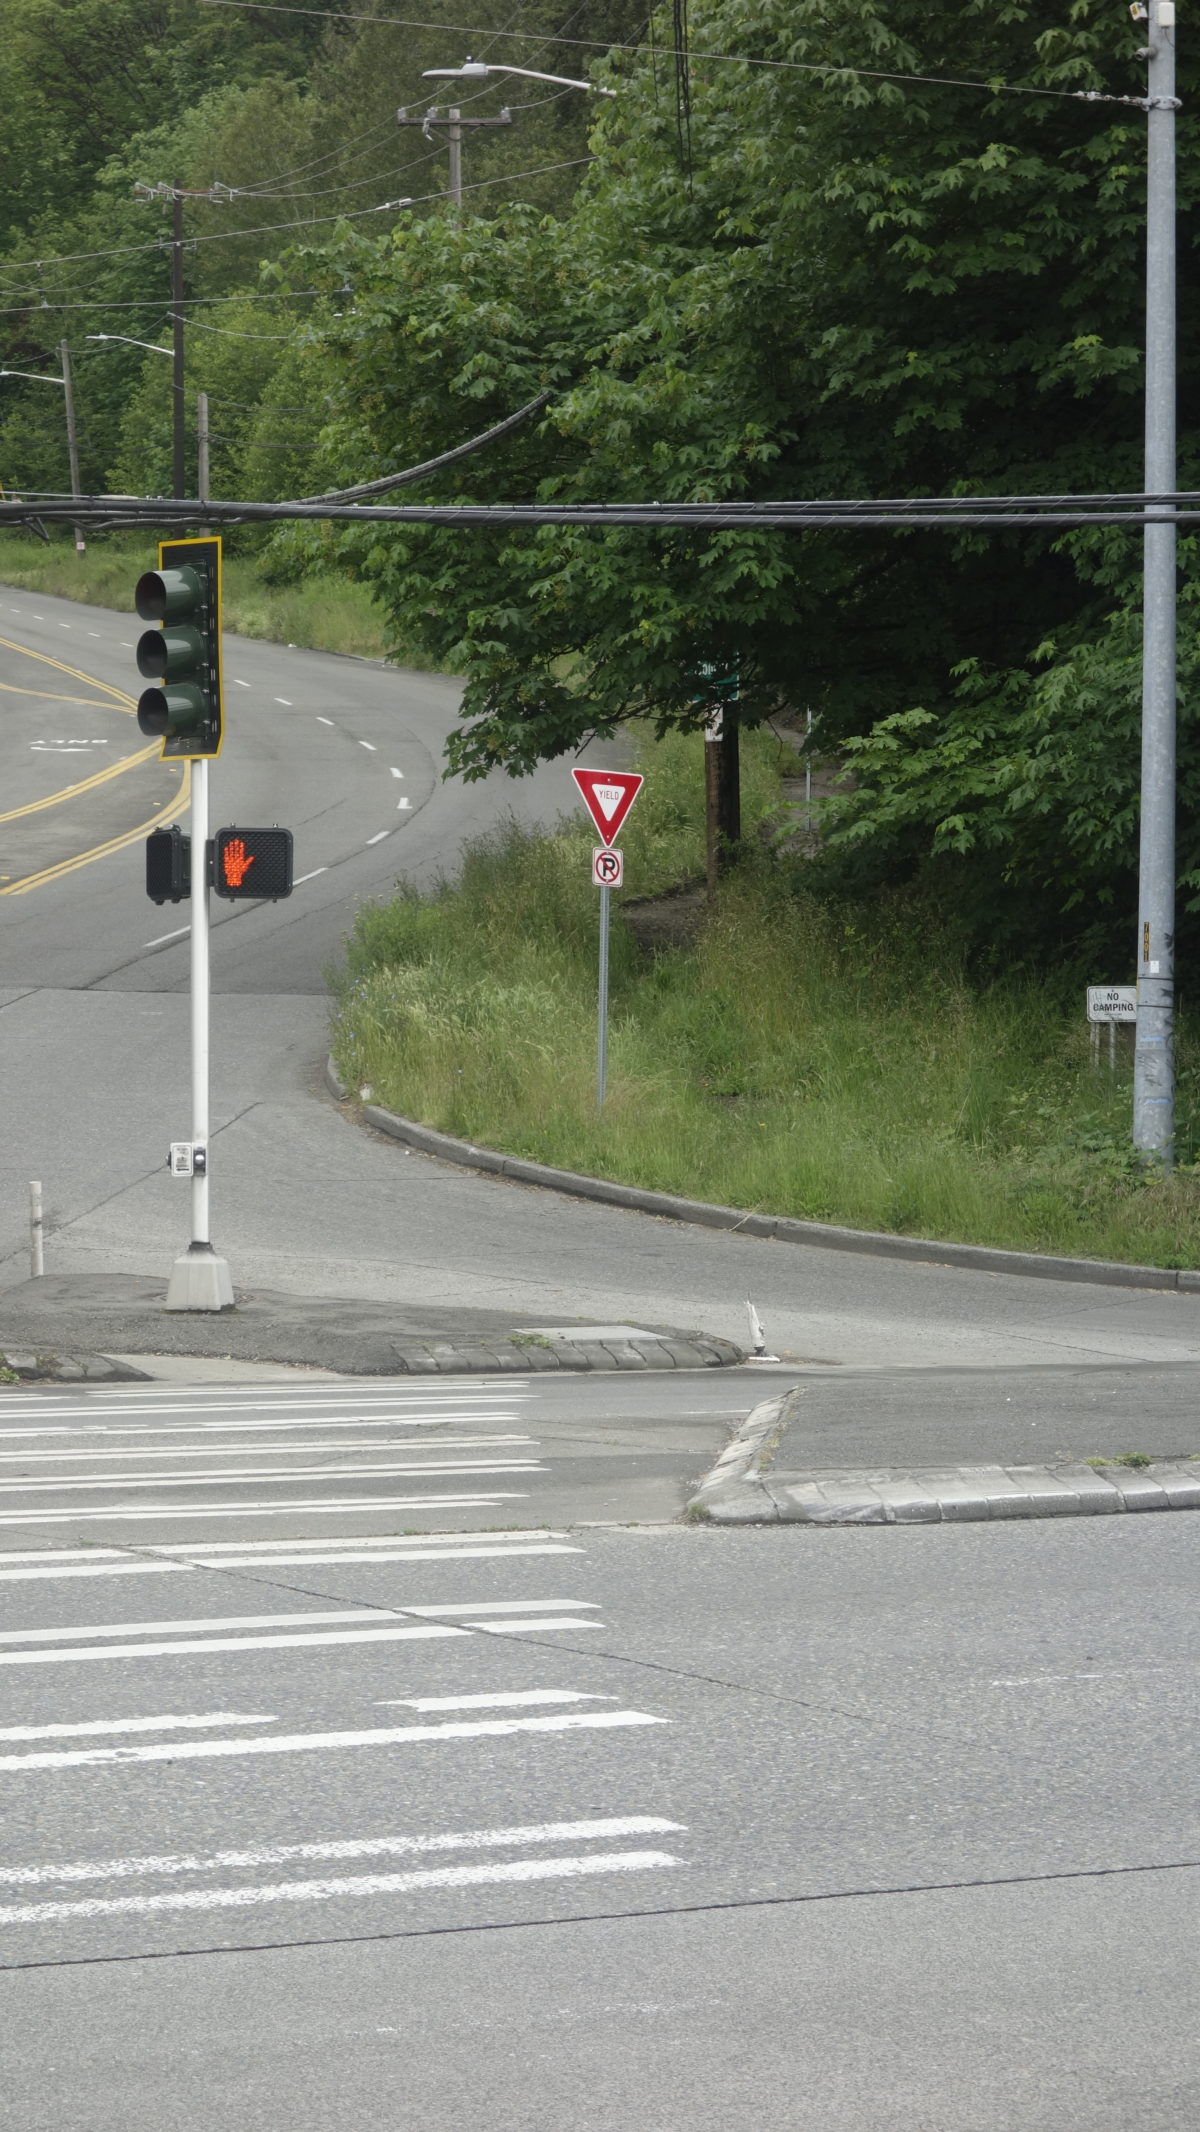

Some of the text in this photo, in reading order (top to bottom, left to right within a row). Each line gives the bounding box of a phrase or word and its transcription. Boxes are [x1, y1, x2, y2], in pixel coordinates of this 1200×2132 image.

[599, 790, 619, 800] YIELD
[1106, 992, 1119, 1001] NO
[1093, 1003, 1134, 1012] CAMPING
